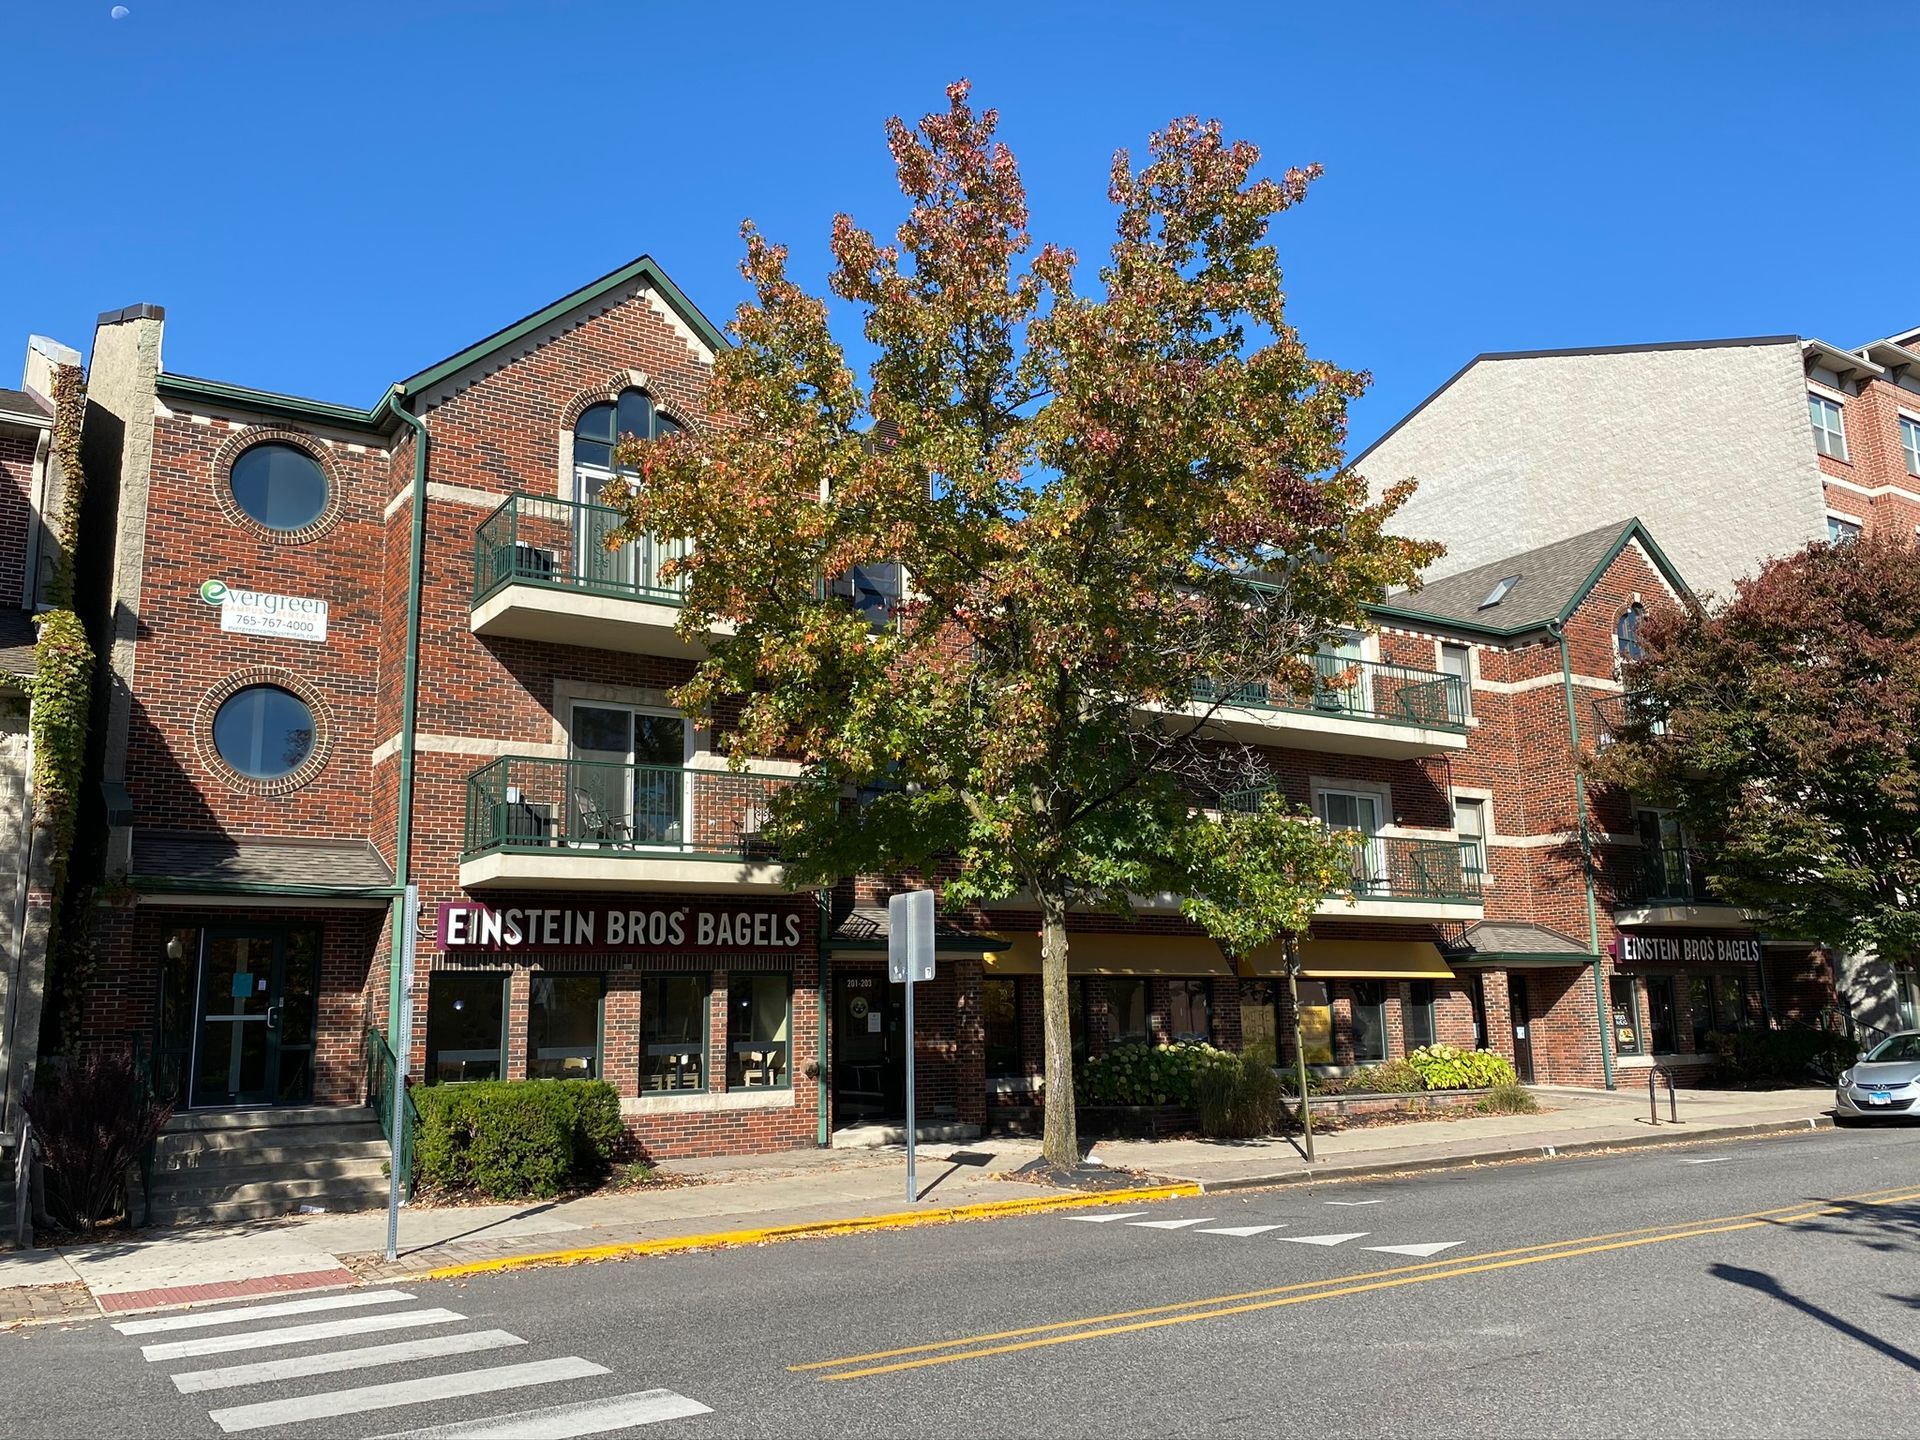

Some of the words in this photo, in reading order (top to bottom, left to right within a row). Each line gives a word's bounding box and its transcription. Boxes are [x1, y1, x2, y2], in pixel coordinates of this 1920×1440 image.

[202, 581, 326, 614] evergreen
[223, 604, 263, 615] CAMPUS
[276, 611, 317, 621] RENTALS
[236, 614, 314, 632] 765-767-4000
[446, 908, 595, 946] EINSTEIN
[697, 912, 800, 947] BAGELS
[1624, 937, 1680, 960] EINSTEIN
[1718, 939, 1759, 962] BAGELS
[847, 979, 872, 988] 201-203
